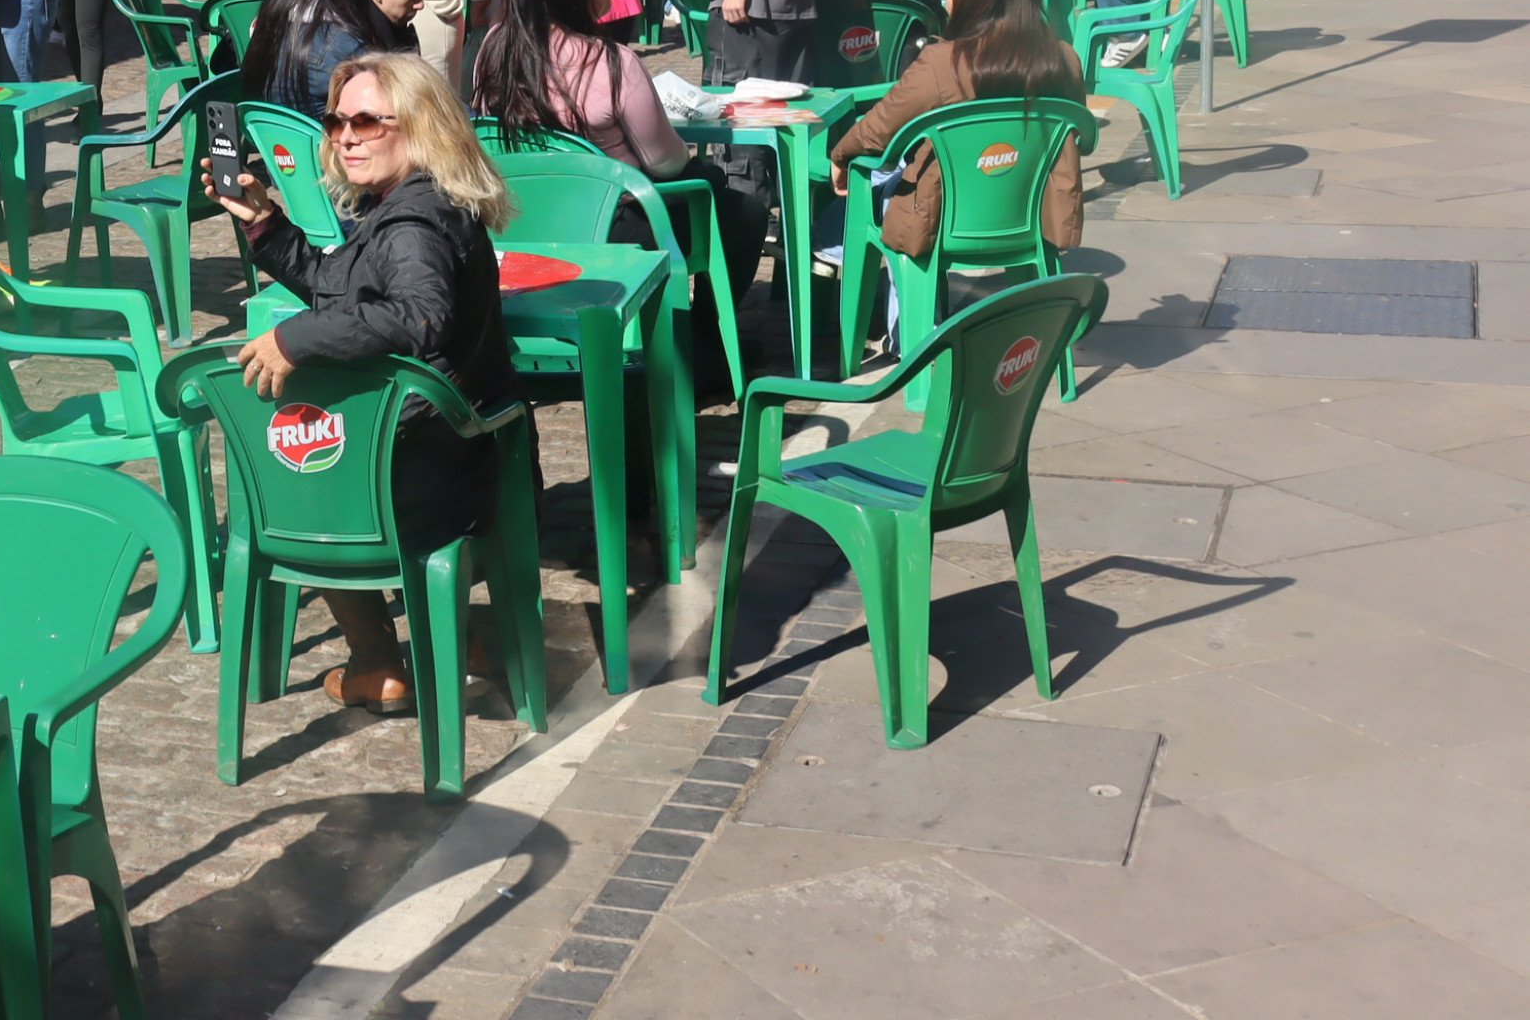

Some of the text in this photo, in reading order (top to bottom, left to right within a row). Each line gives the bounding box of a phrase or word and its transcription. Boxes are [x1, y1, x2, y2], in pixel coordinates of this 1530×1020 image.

[838, 30, 880, 52] FRUKI
[215, 138, 232, 148] FORA
[977, 151, 1019, 169] FRUKI
[995, 341, 1041, 381] FRUKI
[269, 414, 342, 450] FRUKI
